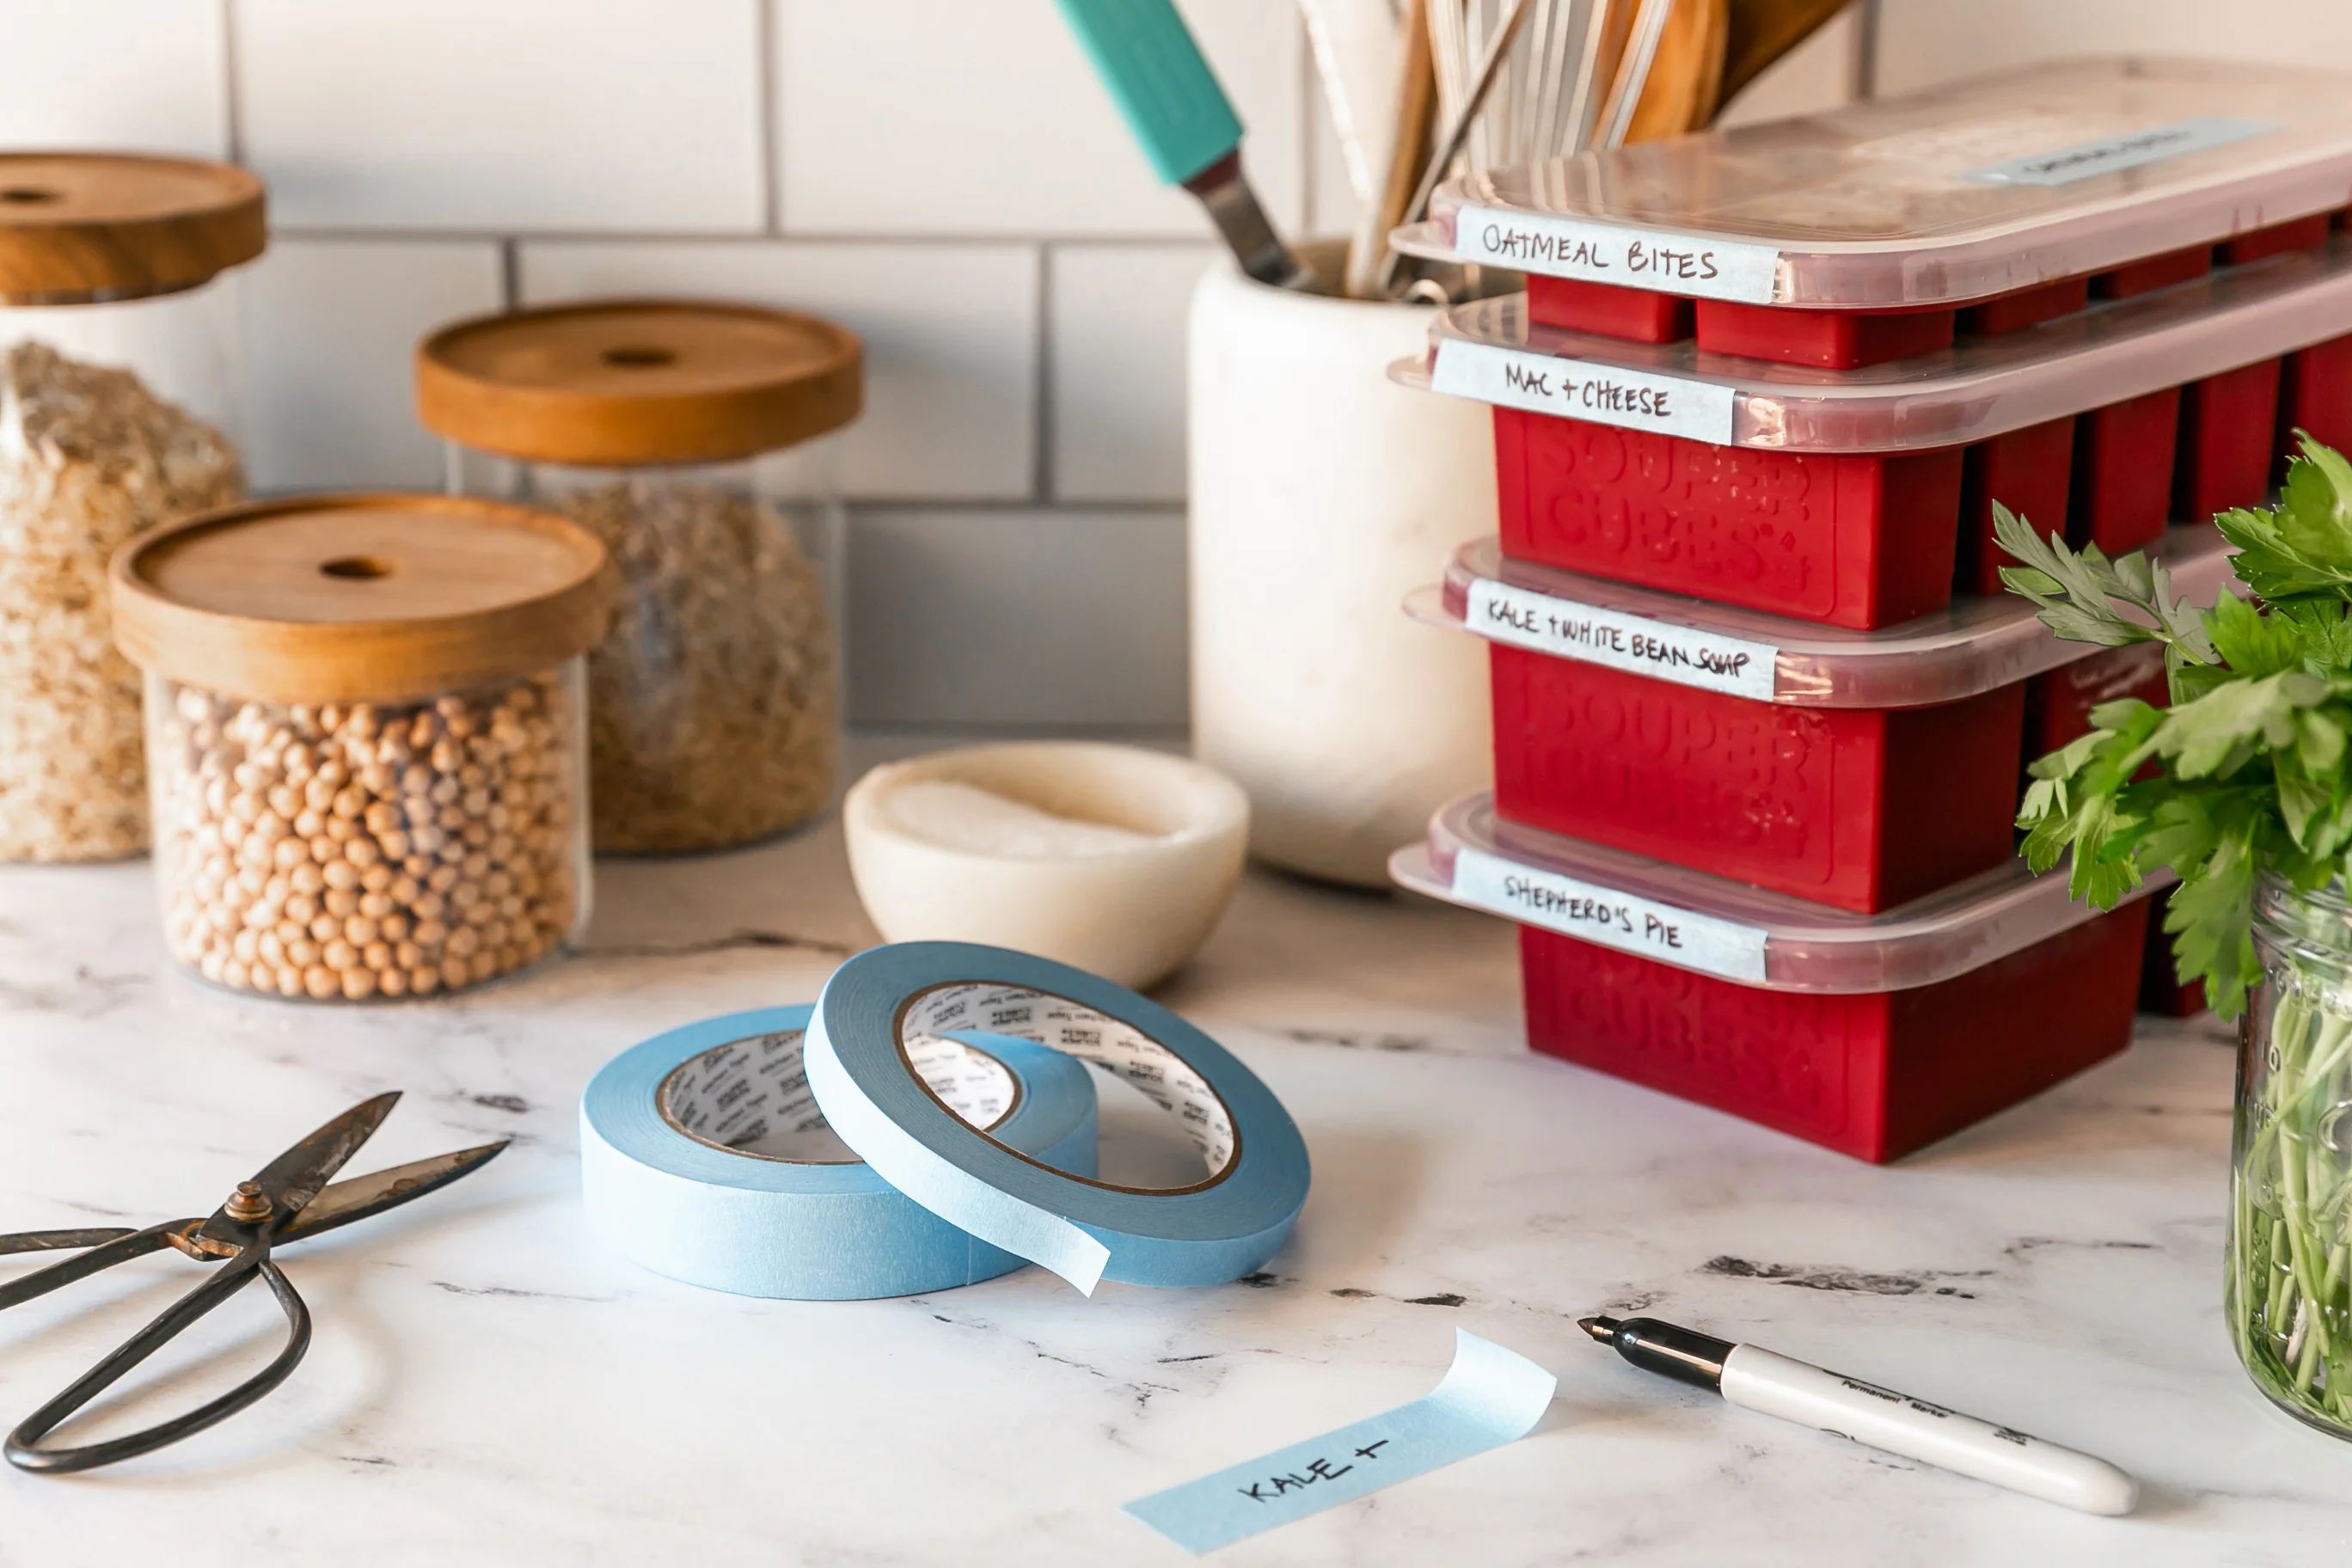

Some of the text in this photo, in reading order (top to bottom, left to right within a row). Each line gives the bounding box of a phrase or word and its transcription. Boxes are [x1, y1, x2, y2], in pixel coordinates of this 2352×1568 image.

[1483, 224, 1718, 279] OATMEAL BITES
[1505, 362, 1553, 396] MAC
[1489, 597, 1540, 633] KALE
[1632, 634, 1690, 666] BEAN
[1691, 647, 1750, 678] SOUP
[1505, 875, 1683, 947] SHEPHERD'S PIE
[1841, 1380, 1949, 1418] Permanent Marker
[1237, 1439, 1389, 1504] KALE +
